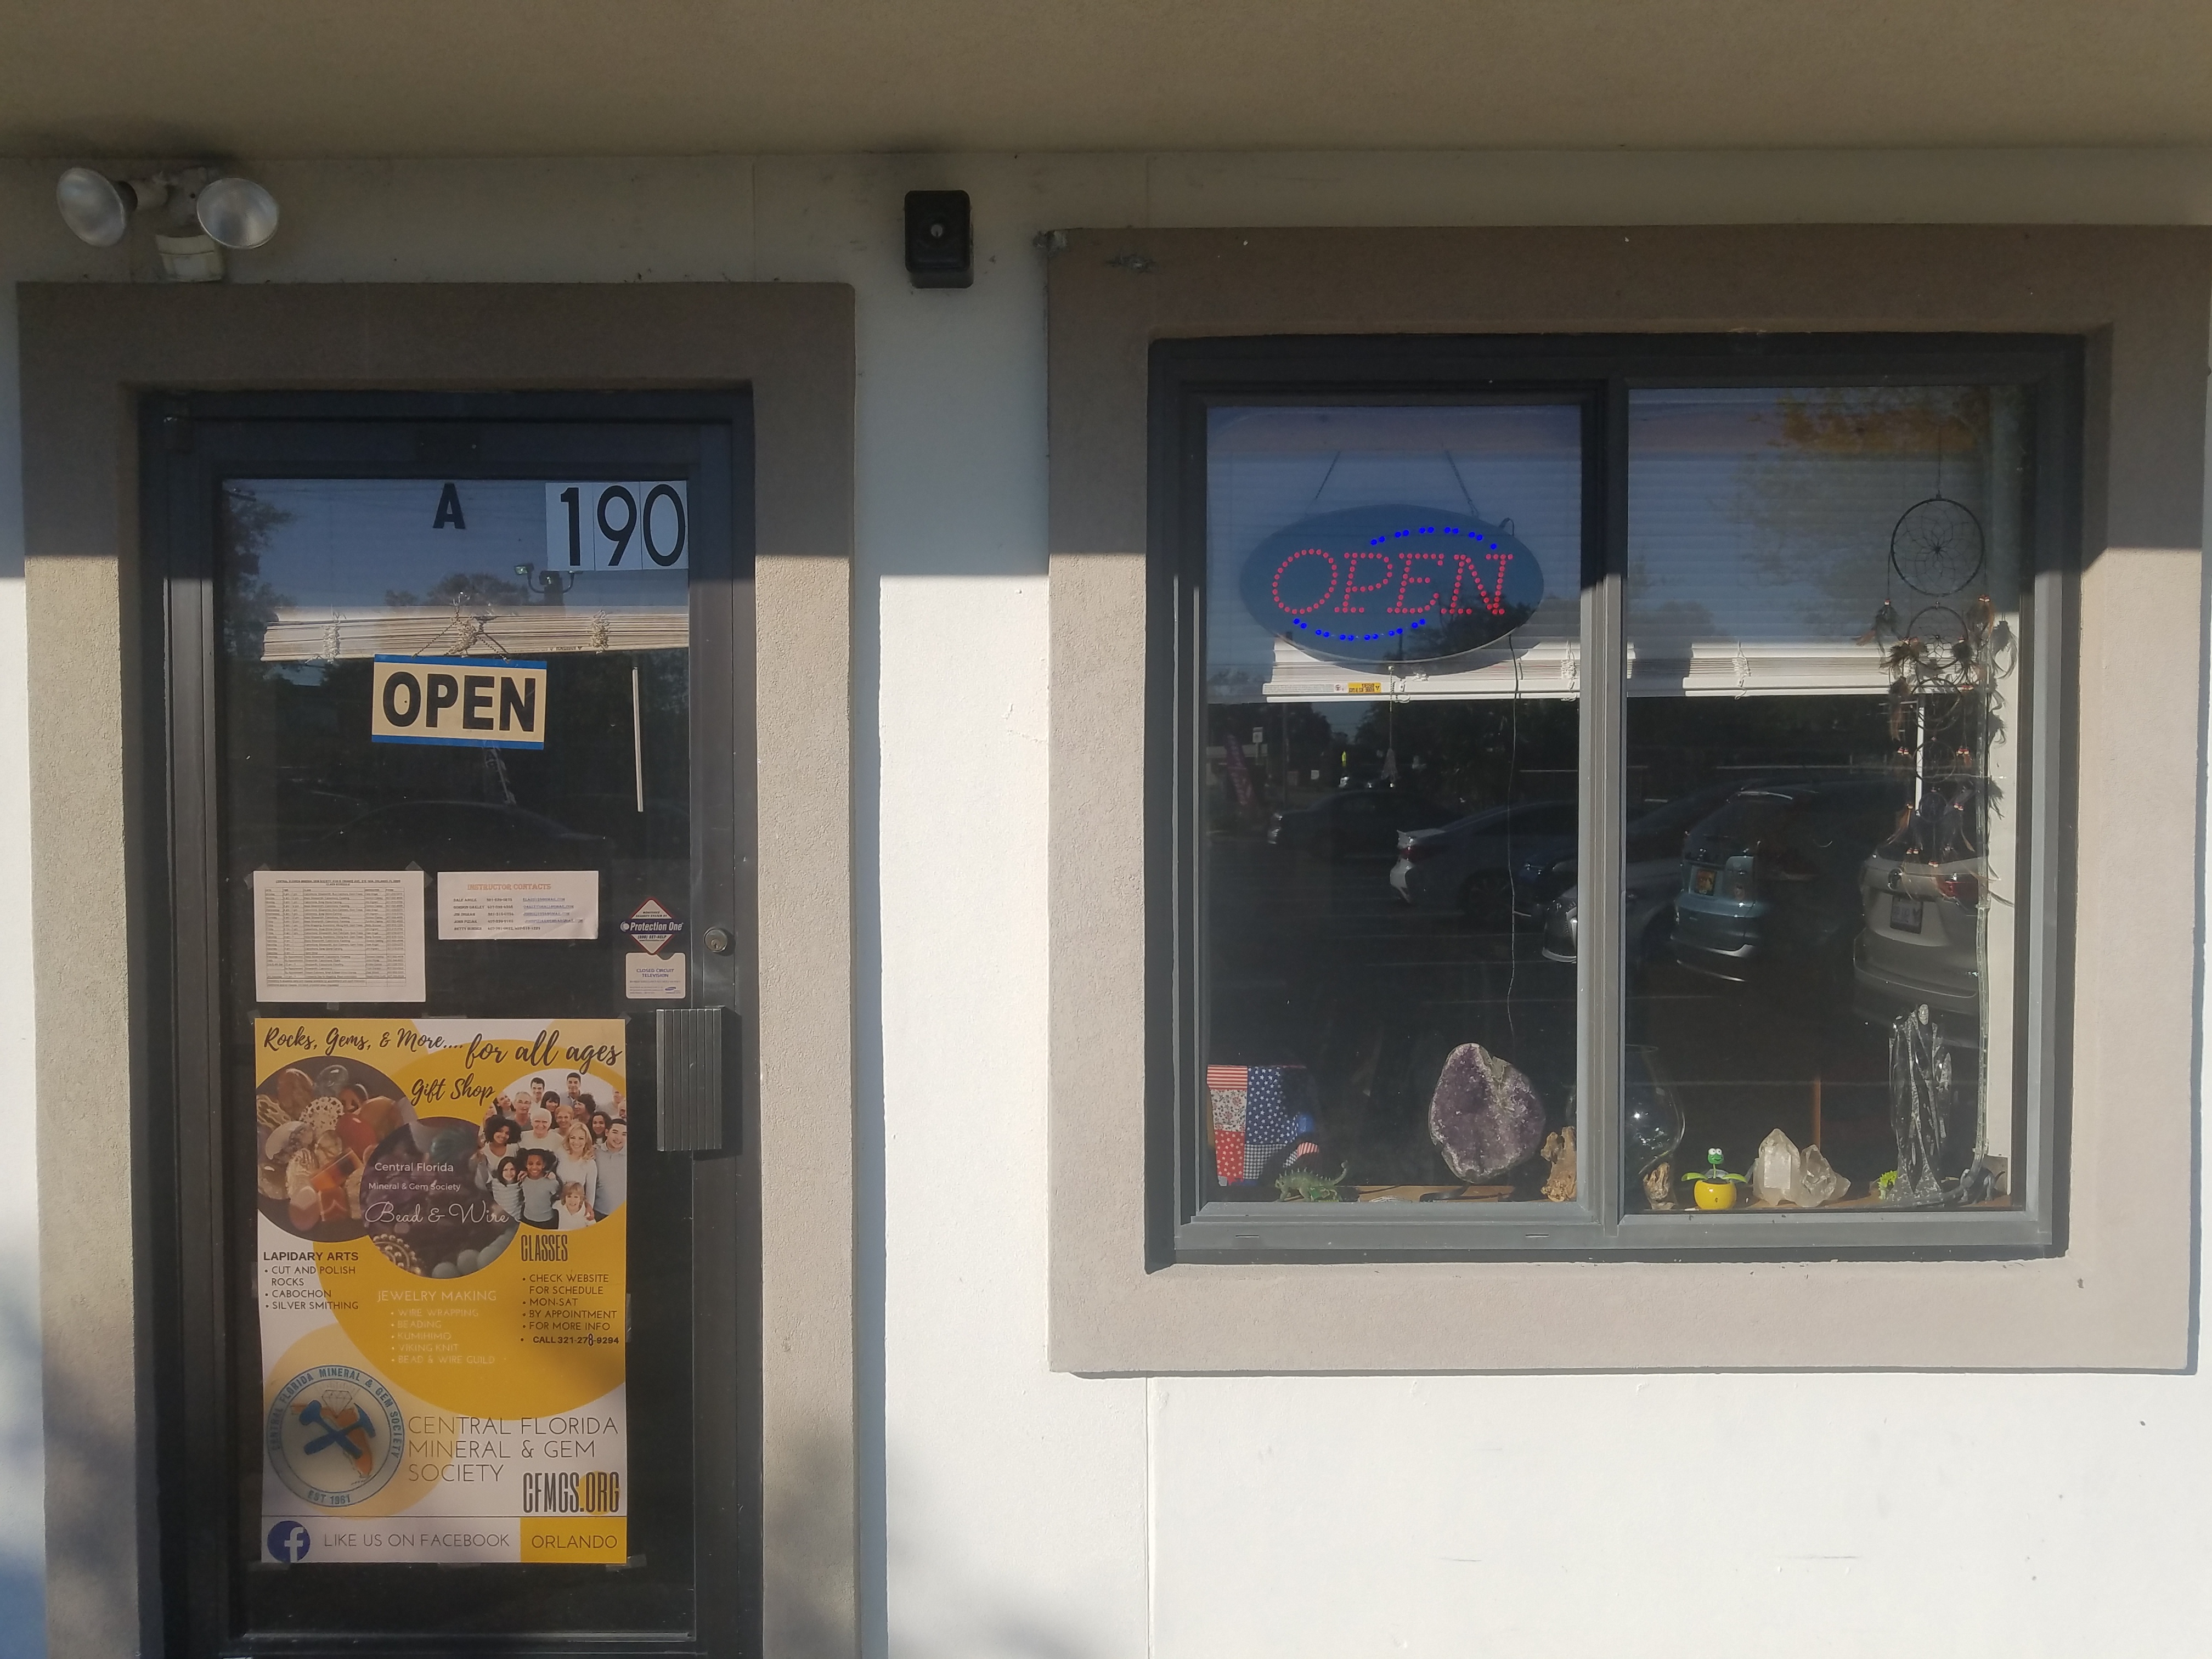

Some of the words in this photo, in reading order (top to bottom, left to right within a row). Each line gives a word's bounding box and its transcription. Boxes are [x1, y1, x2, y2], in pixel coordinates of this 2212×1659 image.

[433, 483, 466, 529] A
[560, 484, 685, 566] 190
[1272, 549, 1513, 614] OPEN
[383, 672, 536, 732] OPEN
[630, 922, 667, 931] Protection
[669, 922, 682, 931] One
[264, 1026, 318, 1051] Rocks,
[325, 1027, 372, 1056] Gems,
[379, 1032, 391, 1048] &
[465, 1033, 508, 1069] for
[515, 1030, 560, 1066] all
[566, 1044, 623, 1075] ages
[410, 1078, 447, 1107] Gift
[450, 1073, 496, 1107] Shop
[374, 1163, 413, 1172] Central
[416, 1163, 454, 1172] Florida
[431, 1183, 461, 1192] Society
[365, 1201, 424, 1222] Bead
[428, 1208, 445, 1222] &
[449, 1200, 510, 1223] Wire
[521, 1234, 568, 1261] CLASSES
[263, 1252, 323, 1260] LAPIDARY
[327, 1252, 359, 1261] ARTS
[529, 1274, 562, 1282] CHECK
[566, 1274, 609, 1283] WEBSITE
[377, 1290, 436, 1302] JEWELRY
[442, 1290, 496, 1301] MAKING
[529, 1286, 549, 1294] FOR
[552, 1286, 603, 1295] SCHEDULE
[272, 1301, 306, 1310] SILVER
[309, 1301, 358, 1310] SMITHING
[545, 1310, 617, 1318] APPOINTMENT
[529, 1322, 549, 1330] FOR
[467, 1356, 495, 1364] GUILD
[280, 1373, 314, 1403] FLORIDA
[319, 1368, 360, 1381] MINERAL
[375, 1387, 393, 1408] GEM
[390, 1411, 403, 1458] SOCIETY
[408, 1416, 511, 1435] CENTRAL
[521, 1417, 618, 1435] FLORIDA
[409, 1440, 511, 1458] MINERAL
[521, 1440, 534, 1458] &
[544, 1440, 595, 1458] GEM
[409, 1464, 504, 1482] SOCIETY
[308, 1490, 326, 1503] EST
[330, 1494, 351, 1504] 1961
[523, 1472, 620, 1513] CFMGS.ORG
[324, 1534, 357, 1547] LIKE
[363, 1534, 382, 1547] US
[388, 1534, 414, 1547] ON
[421, 1534, 510, 1547] FACEBOOK
[532, 1535, 617, 1549] ORLANDO
